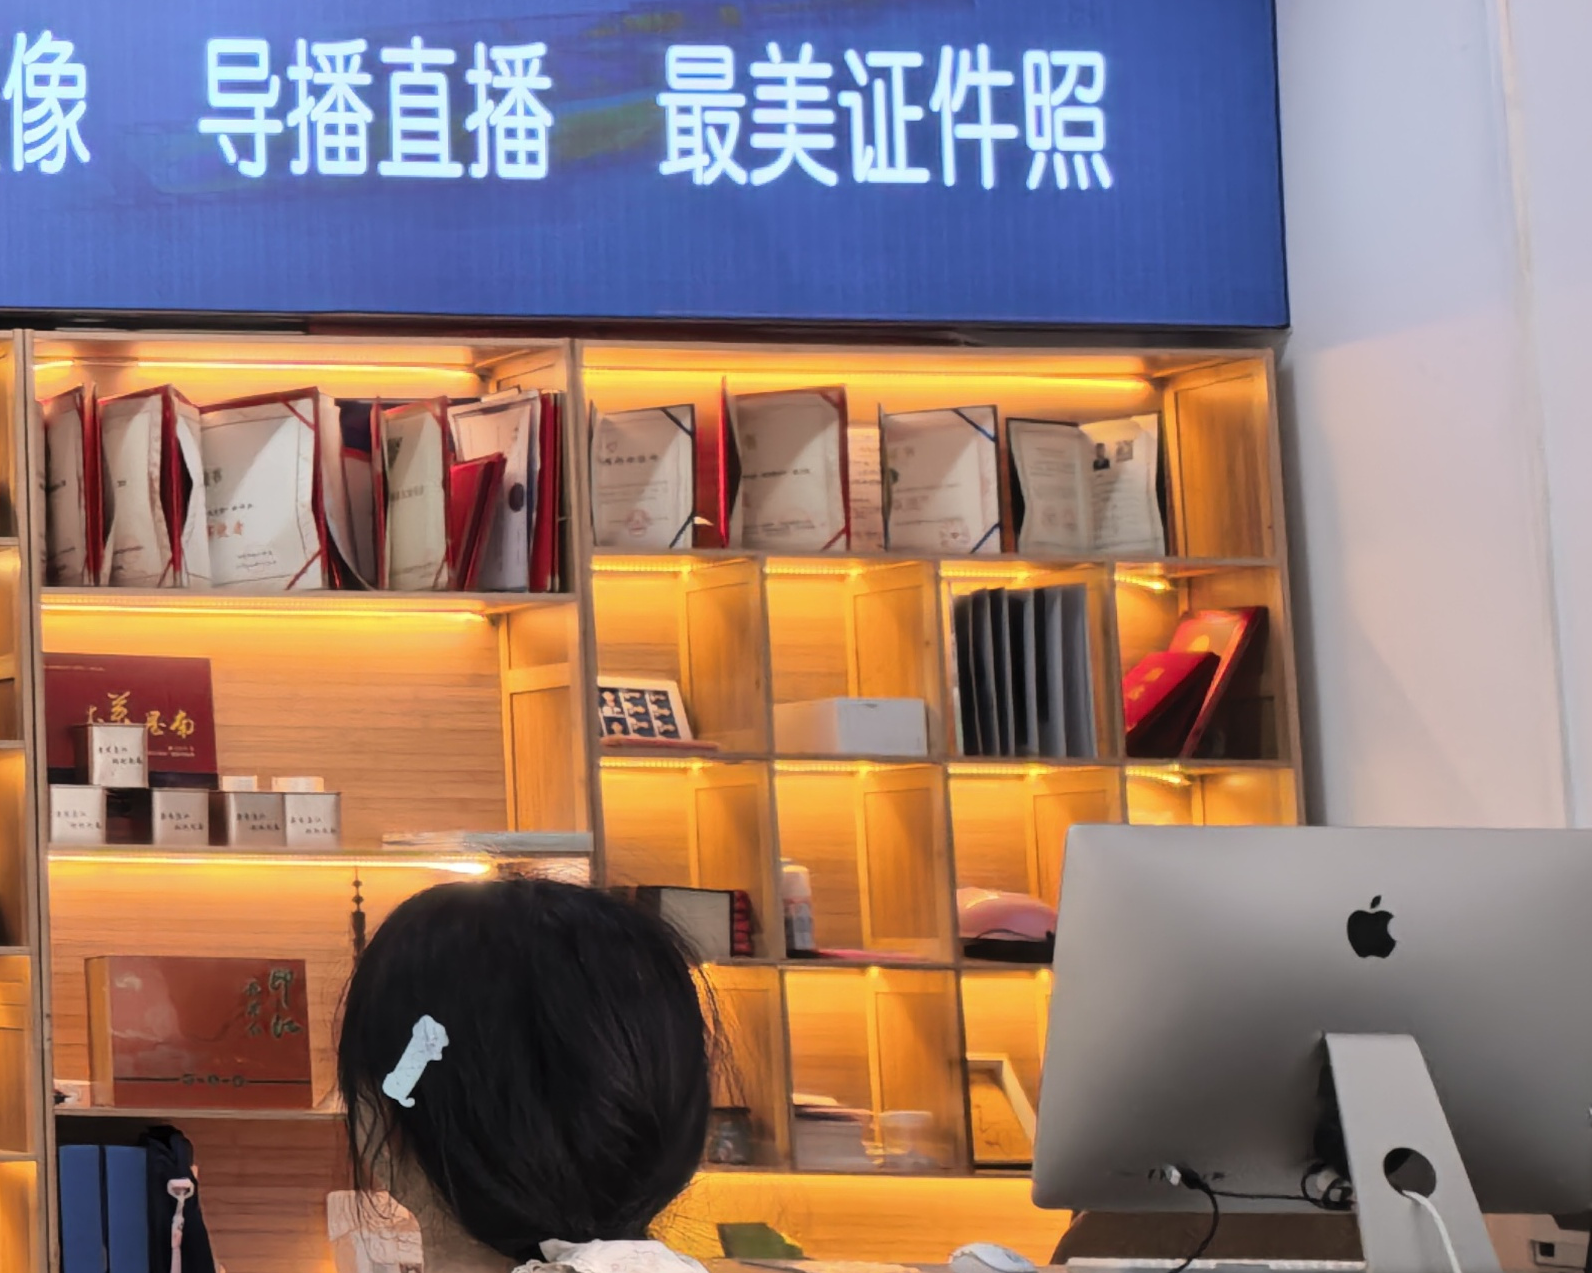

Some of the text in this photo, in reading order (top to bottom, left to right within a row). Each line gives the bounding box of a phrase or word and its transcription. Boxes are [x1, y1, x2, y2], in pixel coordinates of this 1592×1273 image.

[198, 35, 554, 180] 导播直播
[656, 41, 1113, 190] 最美证件照
